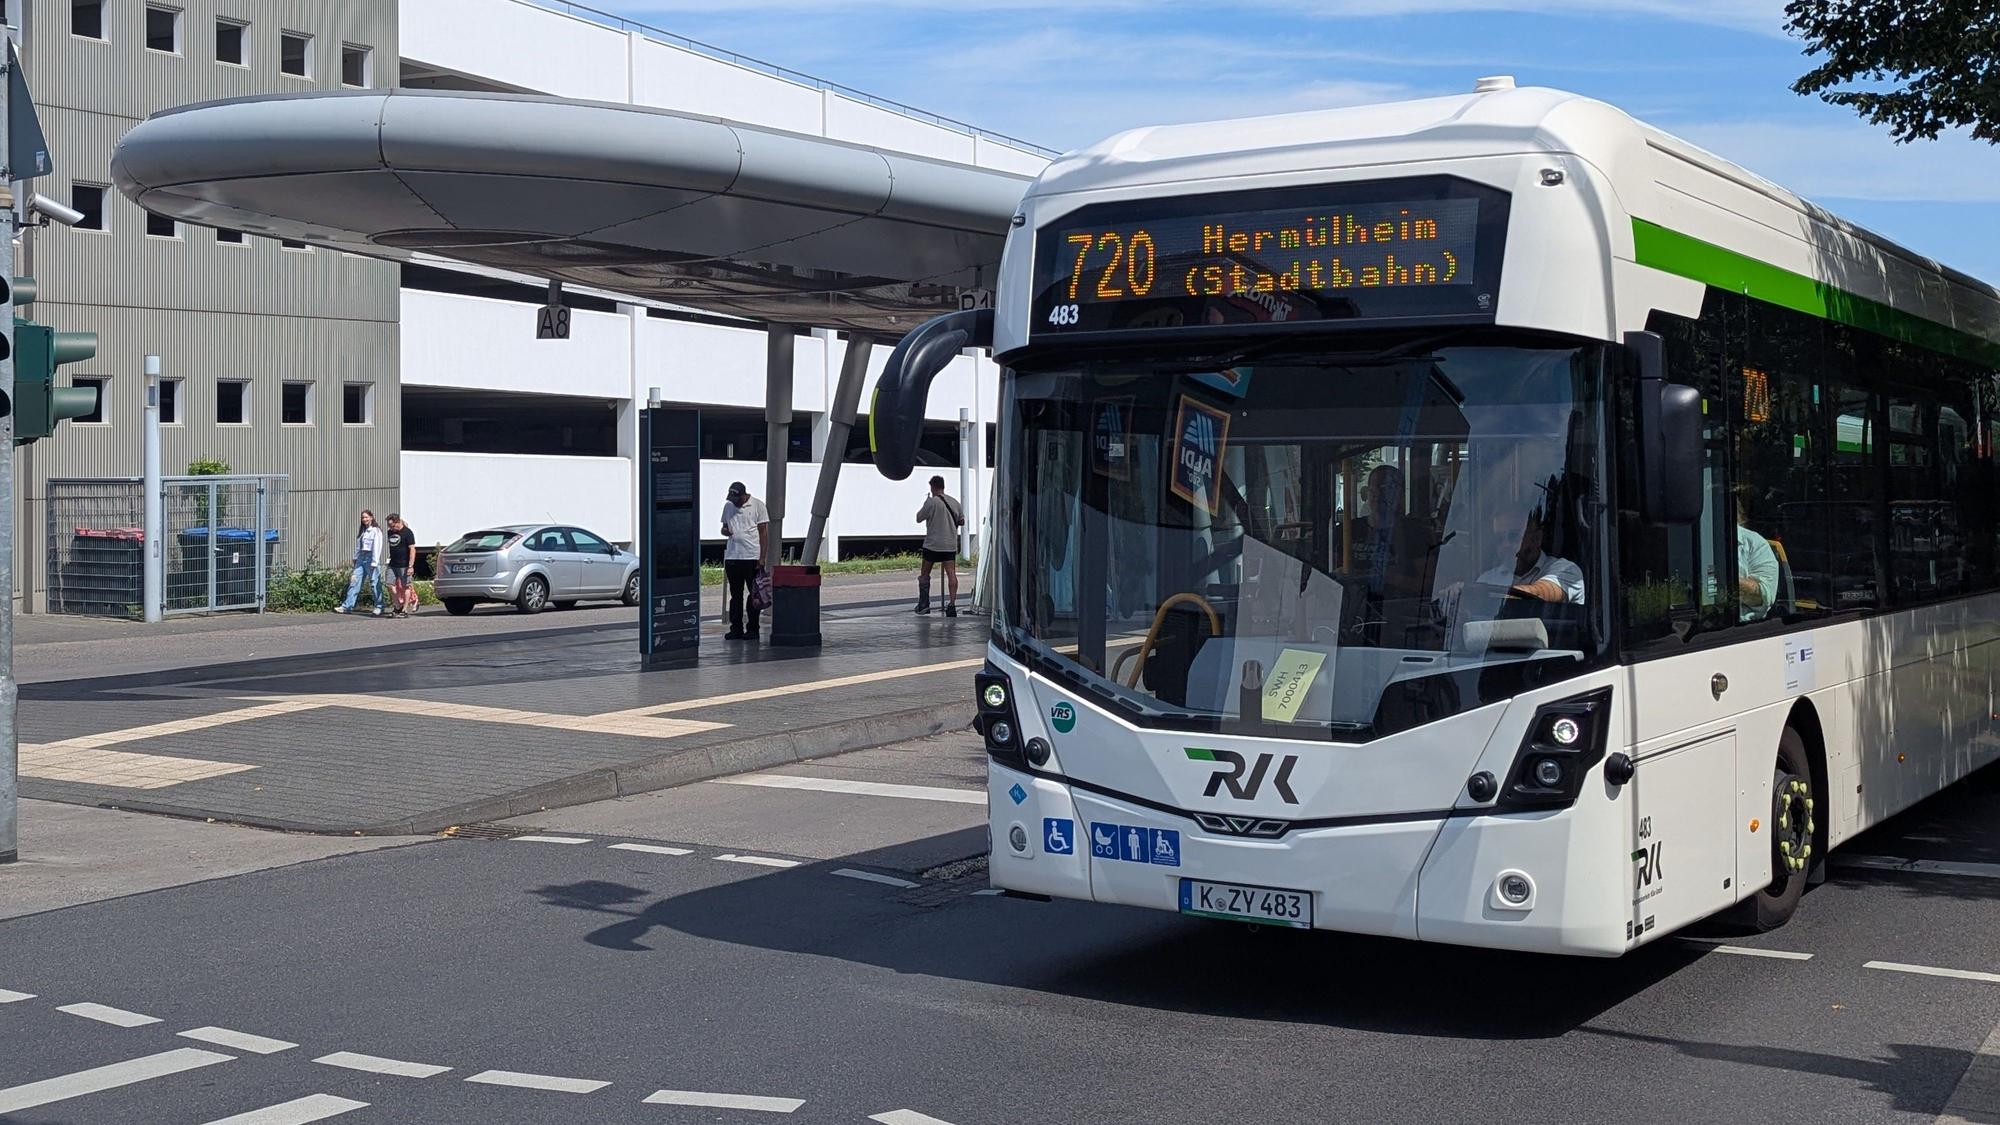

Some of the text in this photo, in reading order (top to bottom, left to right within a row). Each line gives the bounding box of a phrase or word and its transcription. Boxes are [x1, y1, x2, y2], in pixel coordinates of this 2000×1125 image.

[1203, 209, 1437, 254] Hermülheim
[1067, 230, 1155, 299] 720
[1185, 250, 1458, 297] (Stadtbahn)
[539, 308, 568, 338] A8
[1048, 304, 1079, 326] 483
[1269, 671, 1289, 697] SWH
[1278, 663, 1309, 709] 7000413
[1051, 707, 1070, 719] VRS
[1638, 816, 1652, 840] 483
[1200, 886, 1301, 918] K ZY 483
